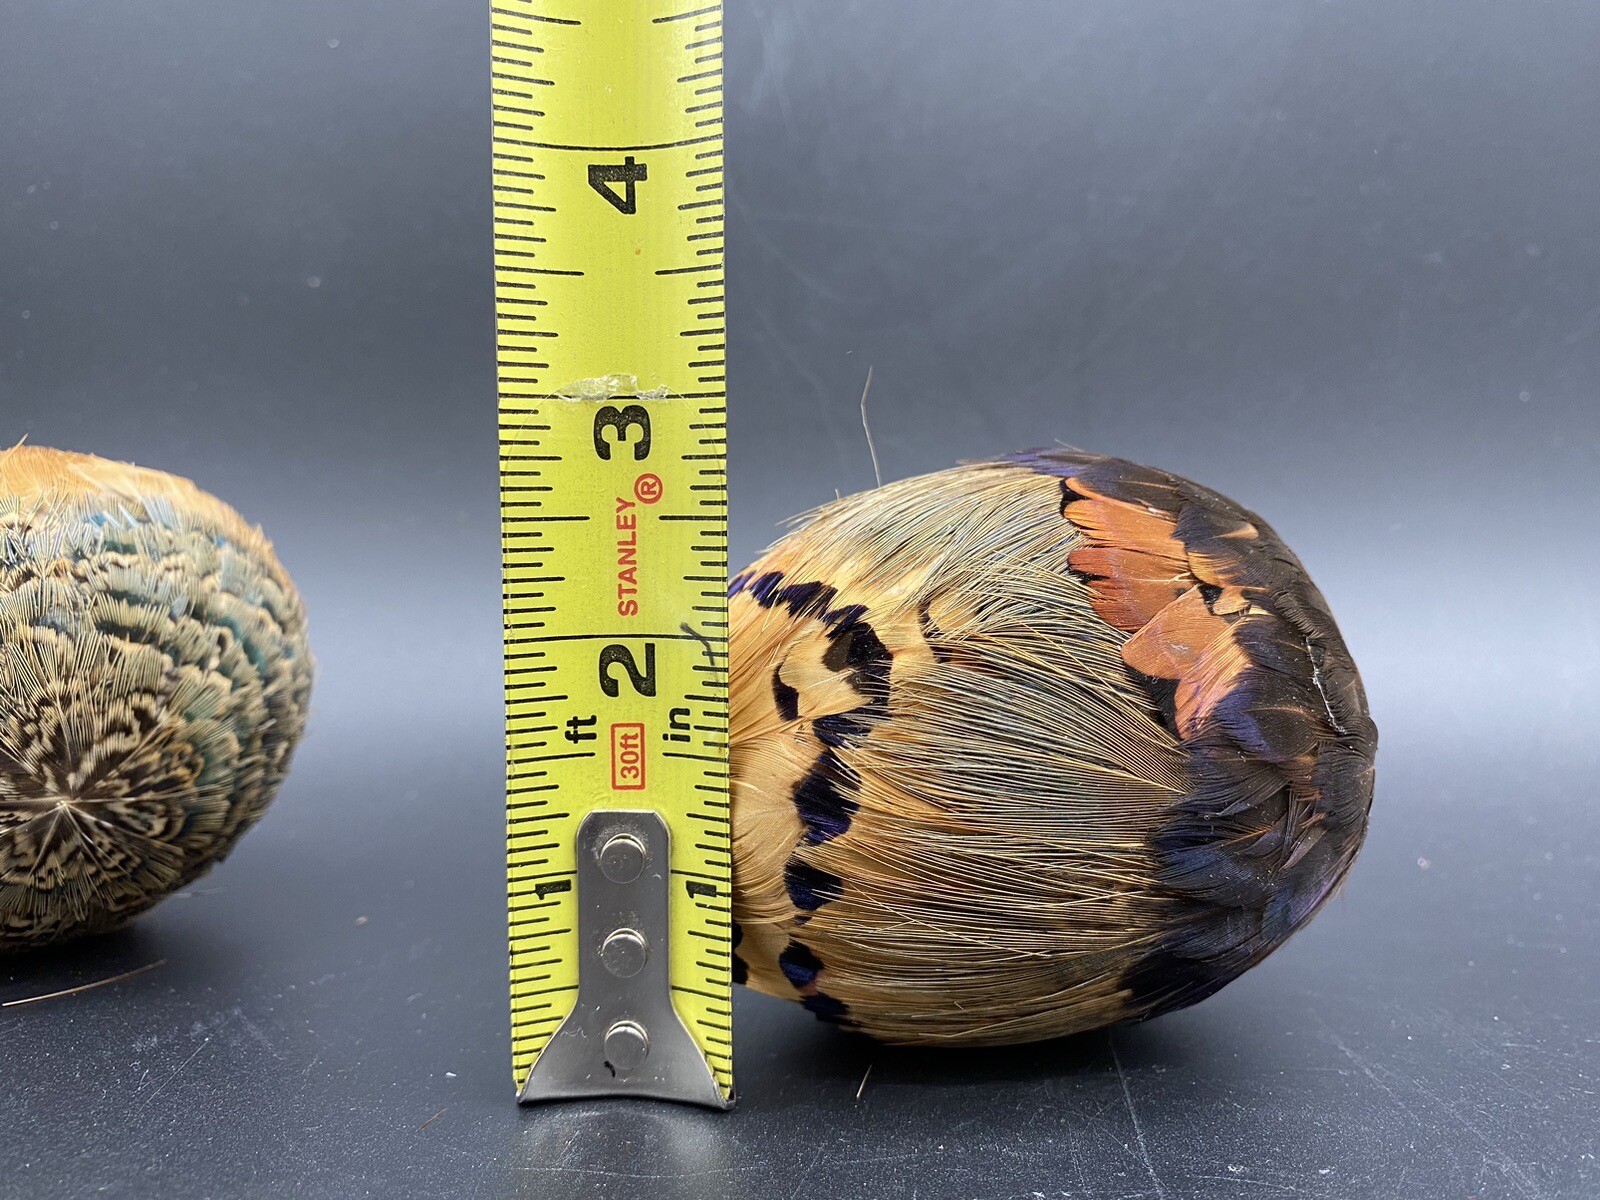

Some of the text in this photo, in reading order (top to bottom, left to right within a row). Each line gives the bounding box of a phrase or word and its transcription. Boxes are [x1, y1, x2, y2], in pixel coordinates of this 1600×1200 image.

[588, 156, 648, 215] 4
[593, 404, 652, 461] 3
[599, 642, 657, 698] 2
[565, 714, 598, 744] ft
[662, 707, 691, 743] in
[620, 732, 640, 780] 30ft
[535, 879, 572, 900] 1
[686, 880, 717, 899] 1
